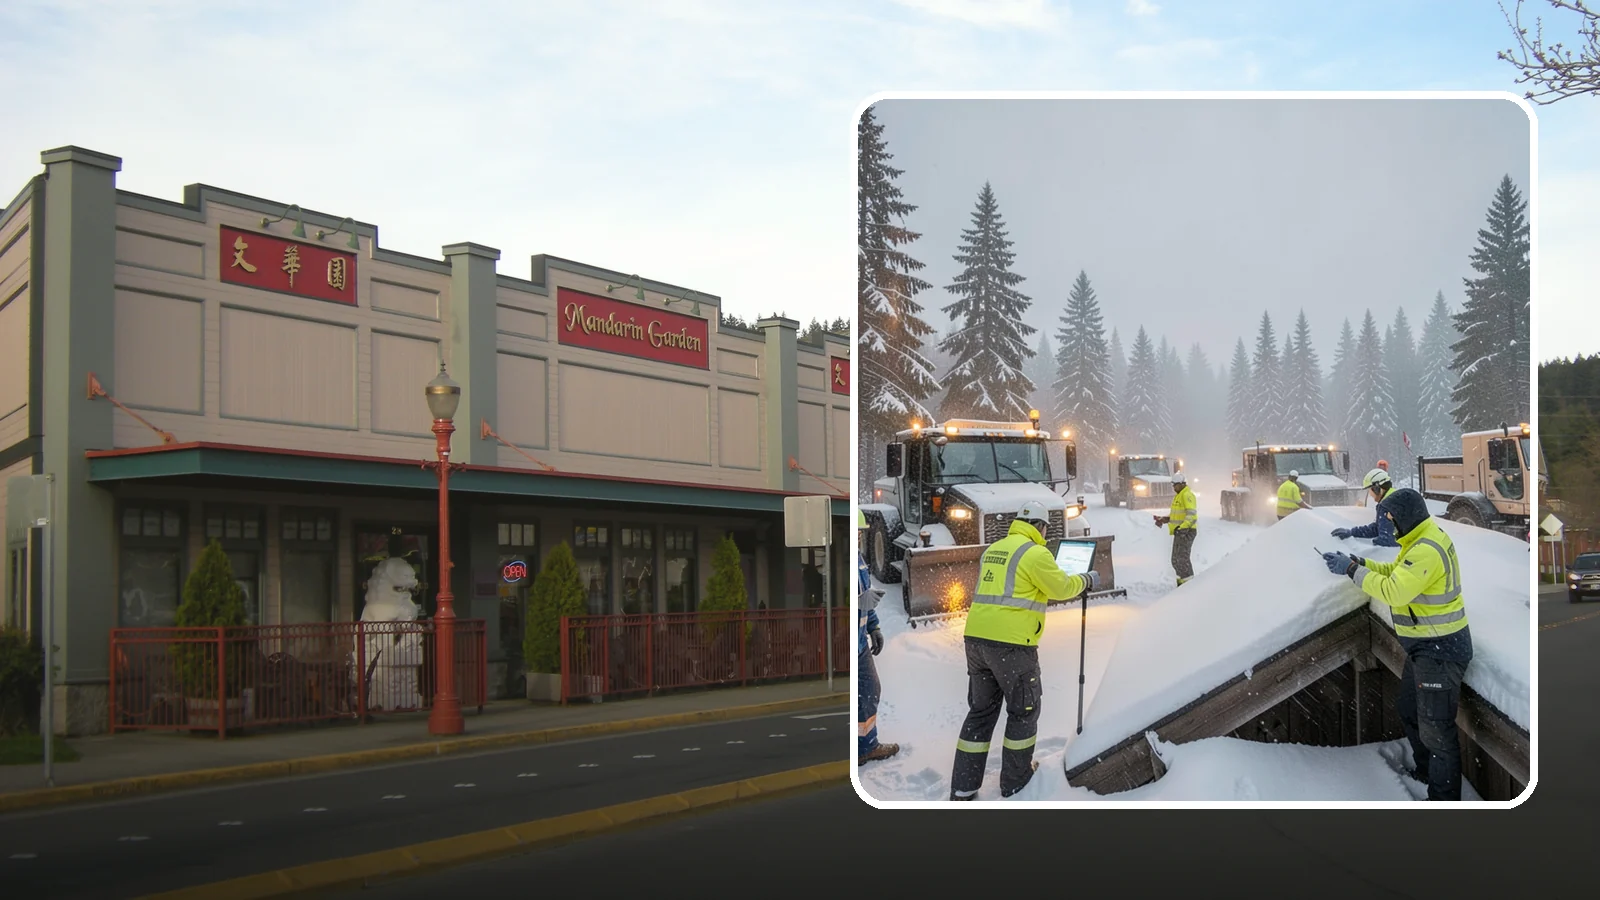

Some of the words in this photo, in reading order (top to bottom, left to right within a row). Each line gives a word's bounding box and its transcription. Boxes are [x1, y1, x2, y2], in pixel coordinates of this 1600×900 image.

[231, 235, 346, 291] 文華園
[564, 302, 644, 341] Mandarin
[648, 320, 701, 352] Garden
[503, 565, 527, 578] OPEN
